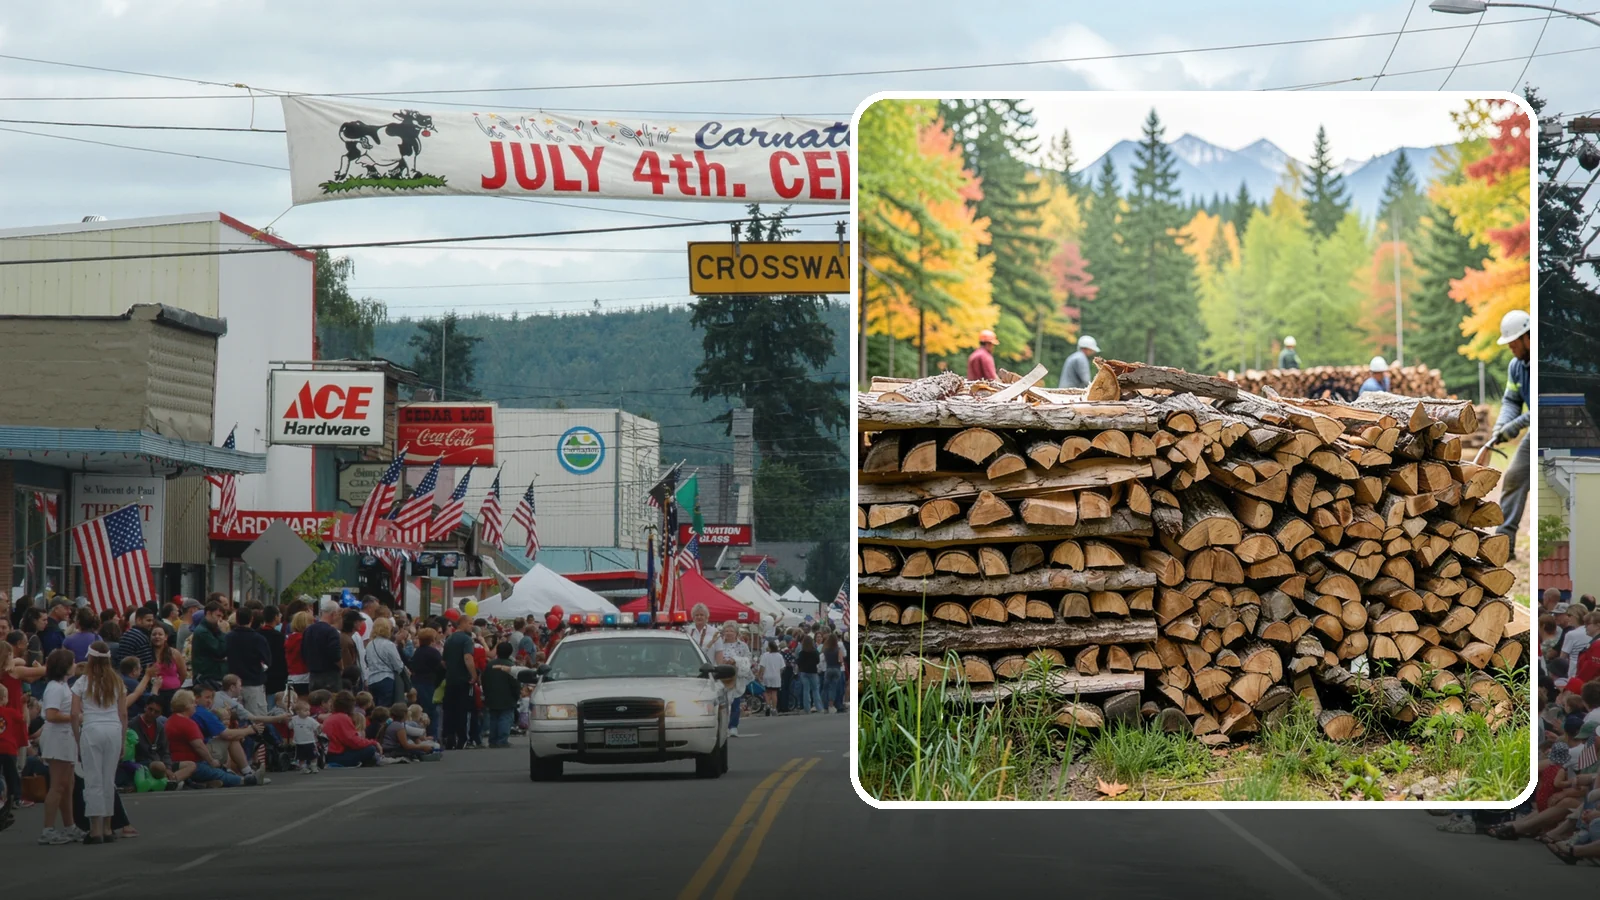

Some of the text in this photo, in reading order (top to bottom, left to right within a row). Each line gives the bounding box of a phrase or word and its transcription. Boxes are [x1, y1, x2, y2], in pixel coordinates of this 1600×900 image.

[695, 121, 850, 150] Carnat
[481, 140, 605, 192] JULY
[632, 150, 746, 198] 4th.
[696, 254, 850, 280] CROSSWA
[282, 380, 373, 420] ACE
[405, 409, 485, 422] CEDAR LOG
[283, 421, 371, 436] Hardware
[83, 485, 155, 496] St. Vincent de Paul
[688, 526, 742, 535] CRNATION
[699, 535, 731, 544] GLASS
